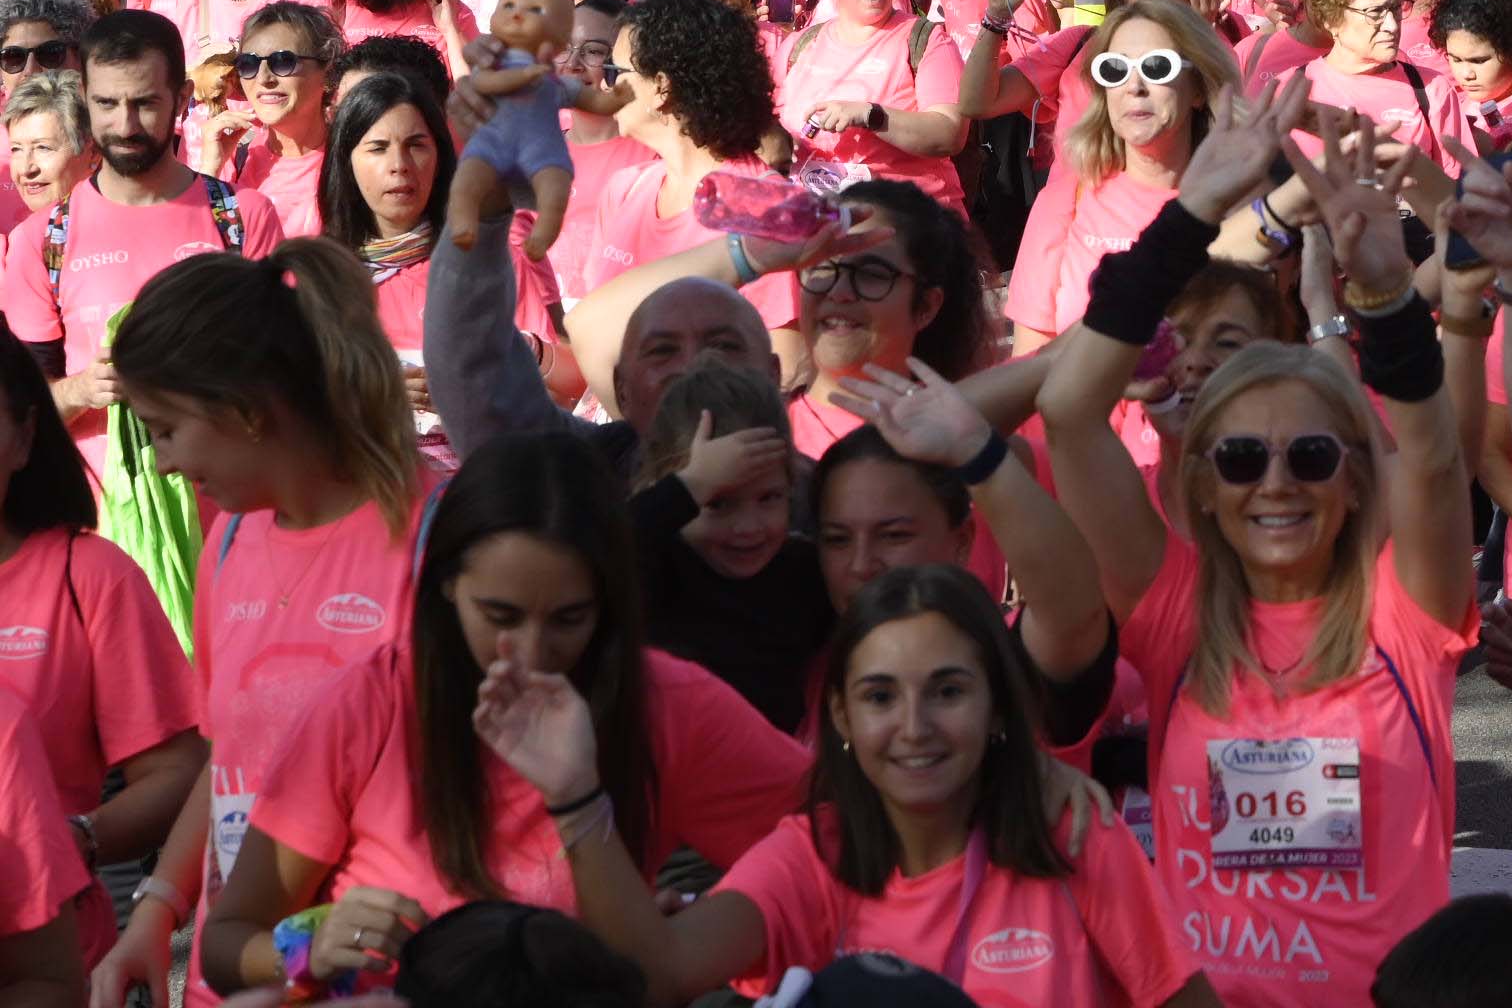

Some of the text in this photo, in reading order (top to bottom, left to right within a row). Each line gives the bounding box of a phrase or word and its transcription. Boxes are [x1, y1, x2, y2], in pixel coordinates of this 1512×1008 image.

[70, 249, 129, 272] OYSHO
[1231, 748, 1308, 765] ASTURIANA
[1236, 790, 1308, 818] 016
[1249, 826, 1295, 844] 4049
[1182, 910, 1324, 965] SUMA
